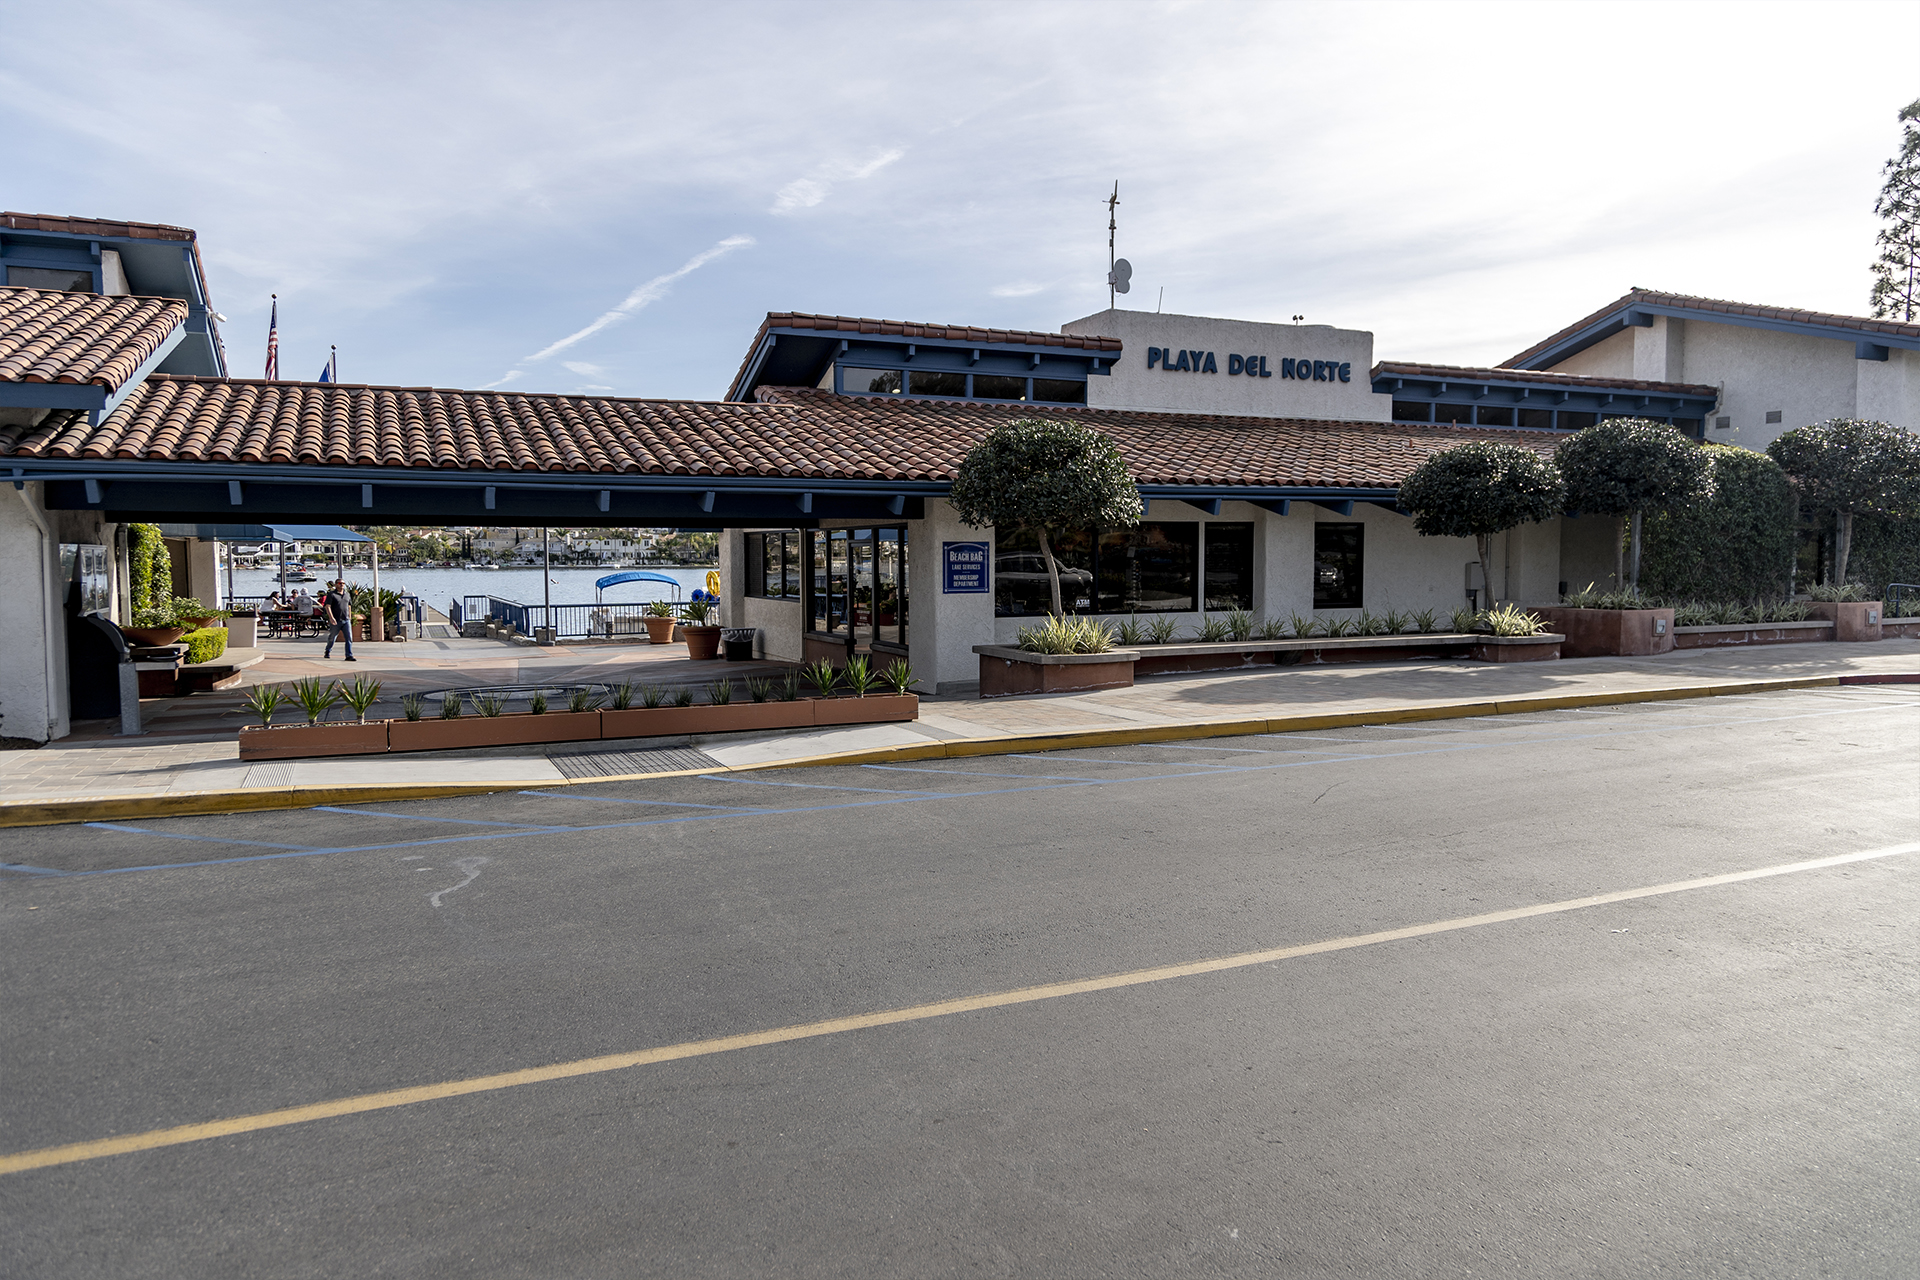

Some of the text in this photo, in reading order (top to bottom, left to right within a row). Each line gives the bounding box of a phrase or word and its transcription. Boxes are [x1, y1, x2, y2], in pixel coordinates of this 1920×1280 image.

[1147, 346, 1351, 383] PLAYA DEL NORTE
[949, 551, 983, 561] BEACH BAG
